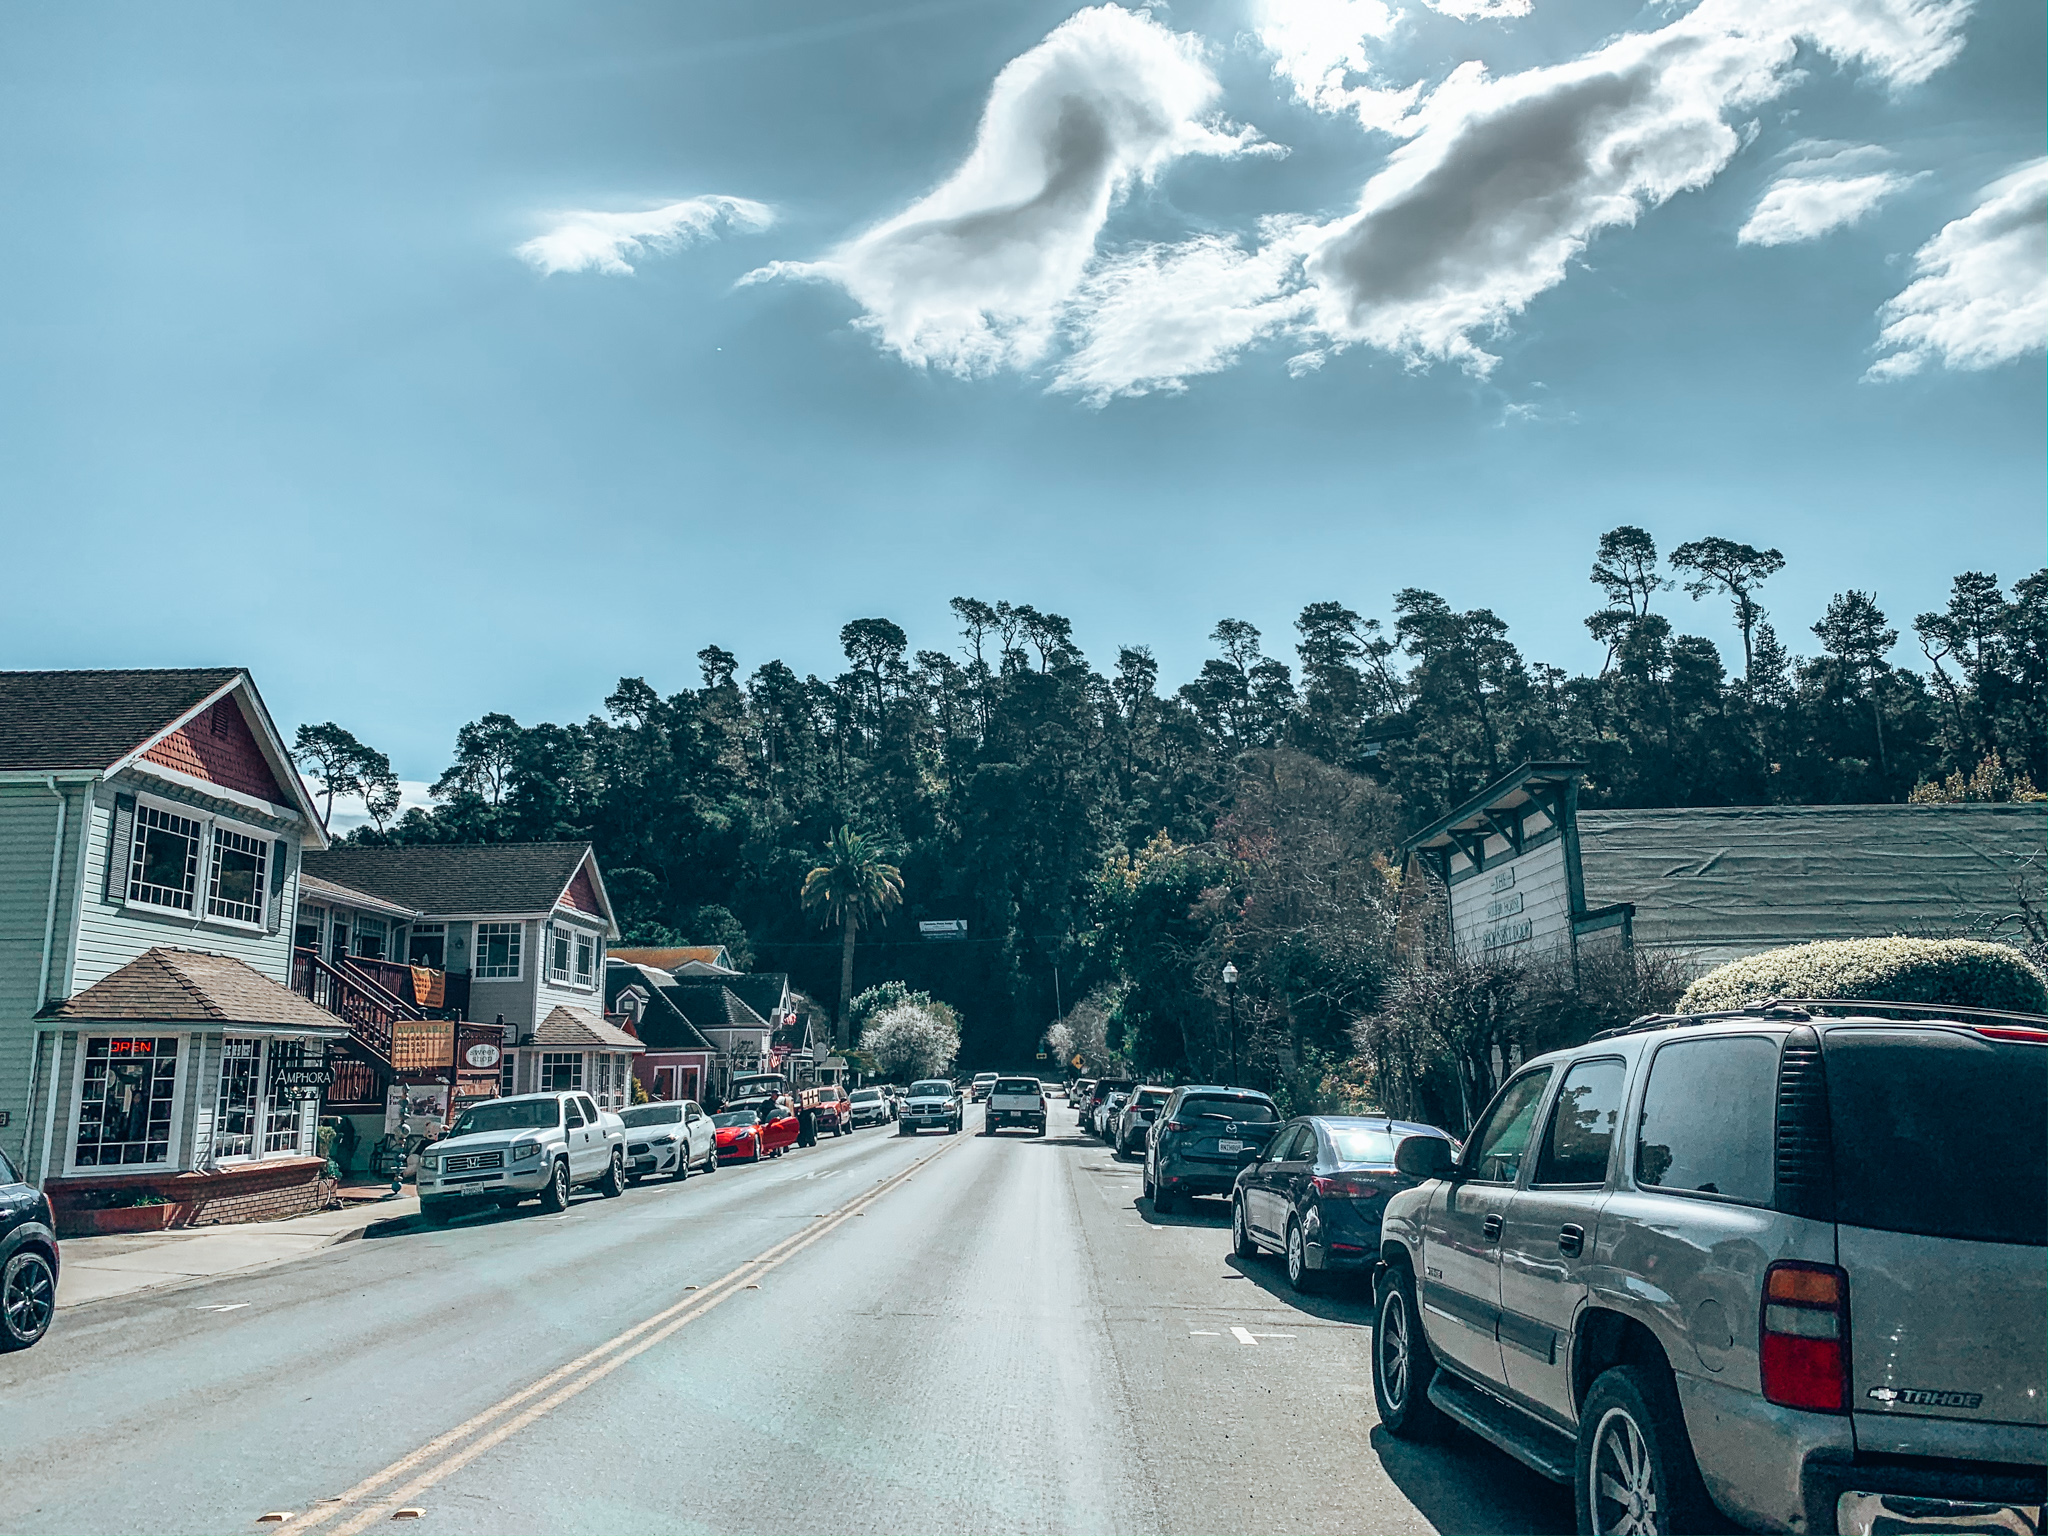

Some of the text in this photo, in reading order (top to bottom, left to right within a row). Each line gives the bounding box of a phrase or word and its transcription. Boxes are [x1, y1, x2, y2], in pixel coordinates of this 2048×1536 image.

[397, 1024, 452, 1034] AVAILABLE
[109, 1041, 152, 1052] OPEN
[472, 1055, 493, 1063] shop
[274, 1068, 332, 1085] AMPHORA
[1902, 1389, 1981, 1407] TAHOE
